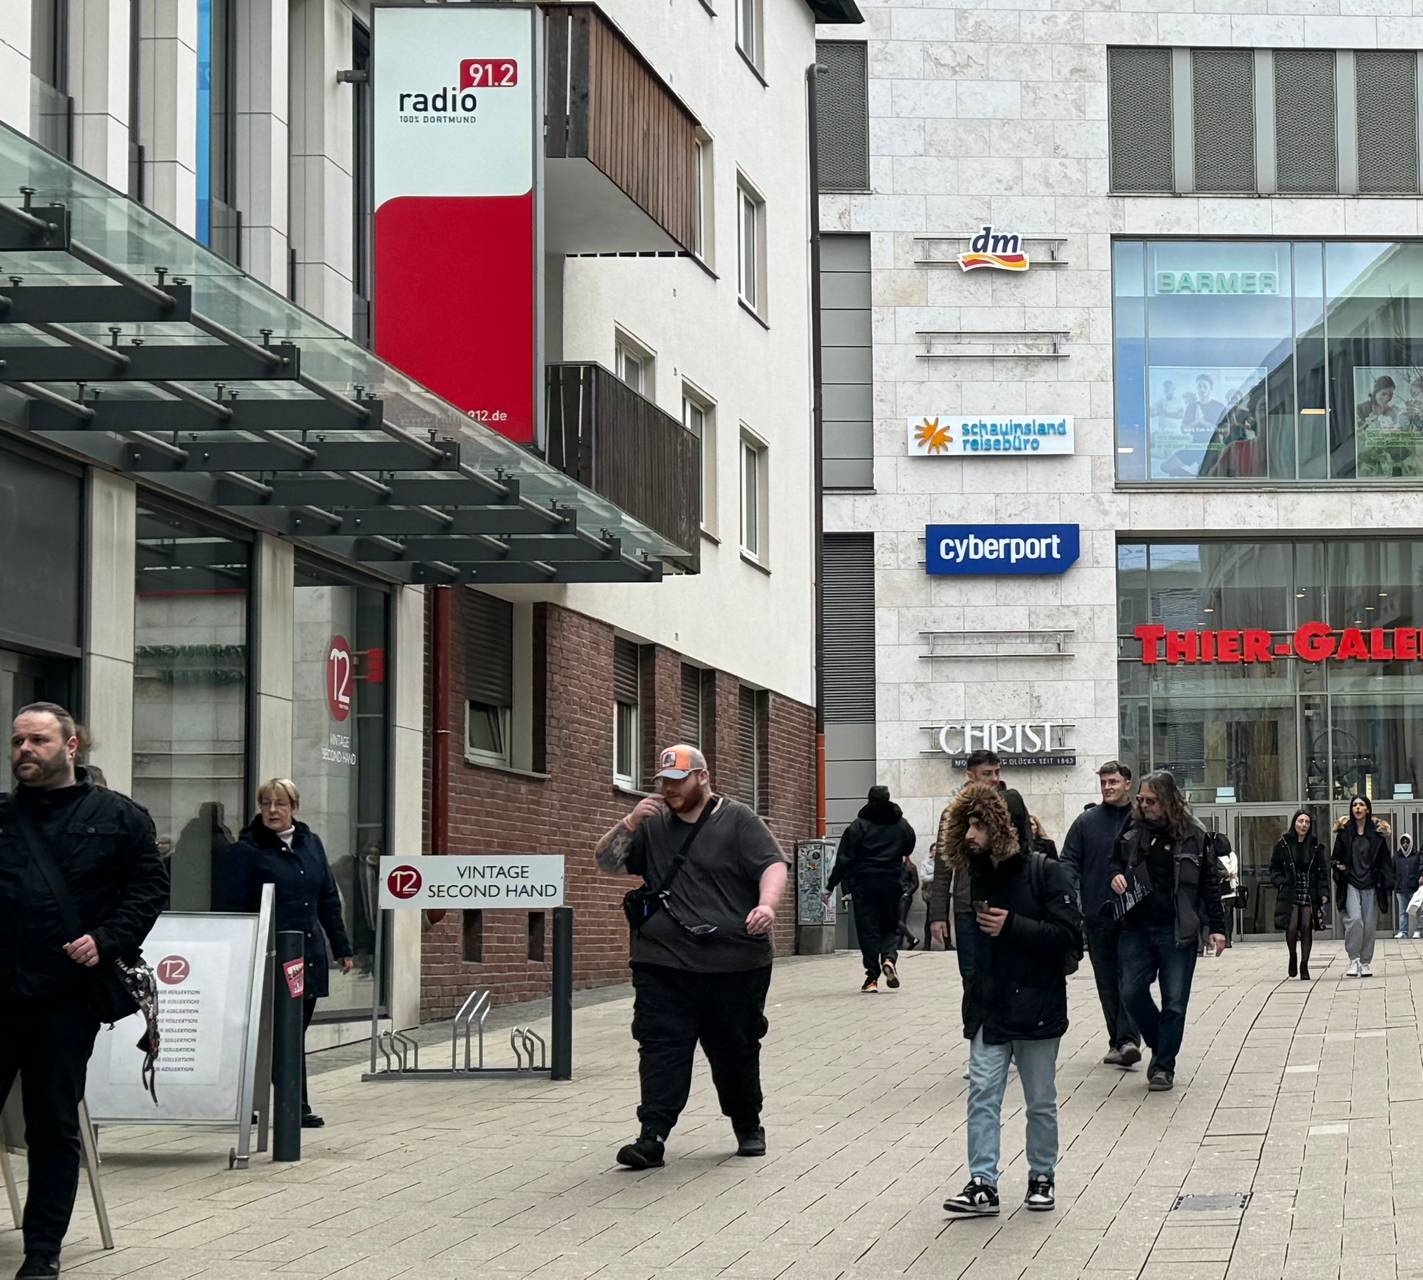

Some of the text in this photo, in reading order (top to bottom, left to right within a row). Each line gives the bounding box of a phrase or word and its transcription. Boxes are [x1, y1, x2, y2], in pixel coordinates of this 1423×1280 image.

[468, 63, 515, 87] 91.2
[399, 86, 477, 112] radio
[423, 115, 477, 123] DORTMUND
[971, 226, 1020, 254] dm
[1157, 271, 1278, 294] BARMER
[961, 419, 1067, 436] schauinsland
[962, 434, 1040, 451] reisebüro
[939, 534, 1061, 564] cyberport
[939, 721, 1054, 755] CHRIST
[456, 865, 530, 879] VINTAGE
[427, 884, 557, 898] SECOND HAND
